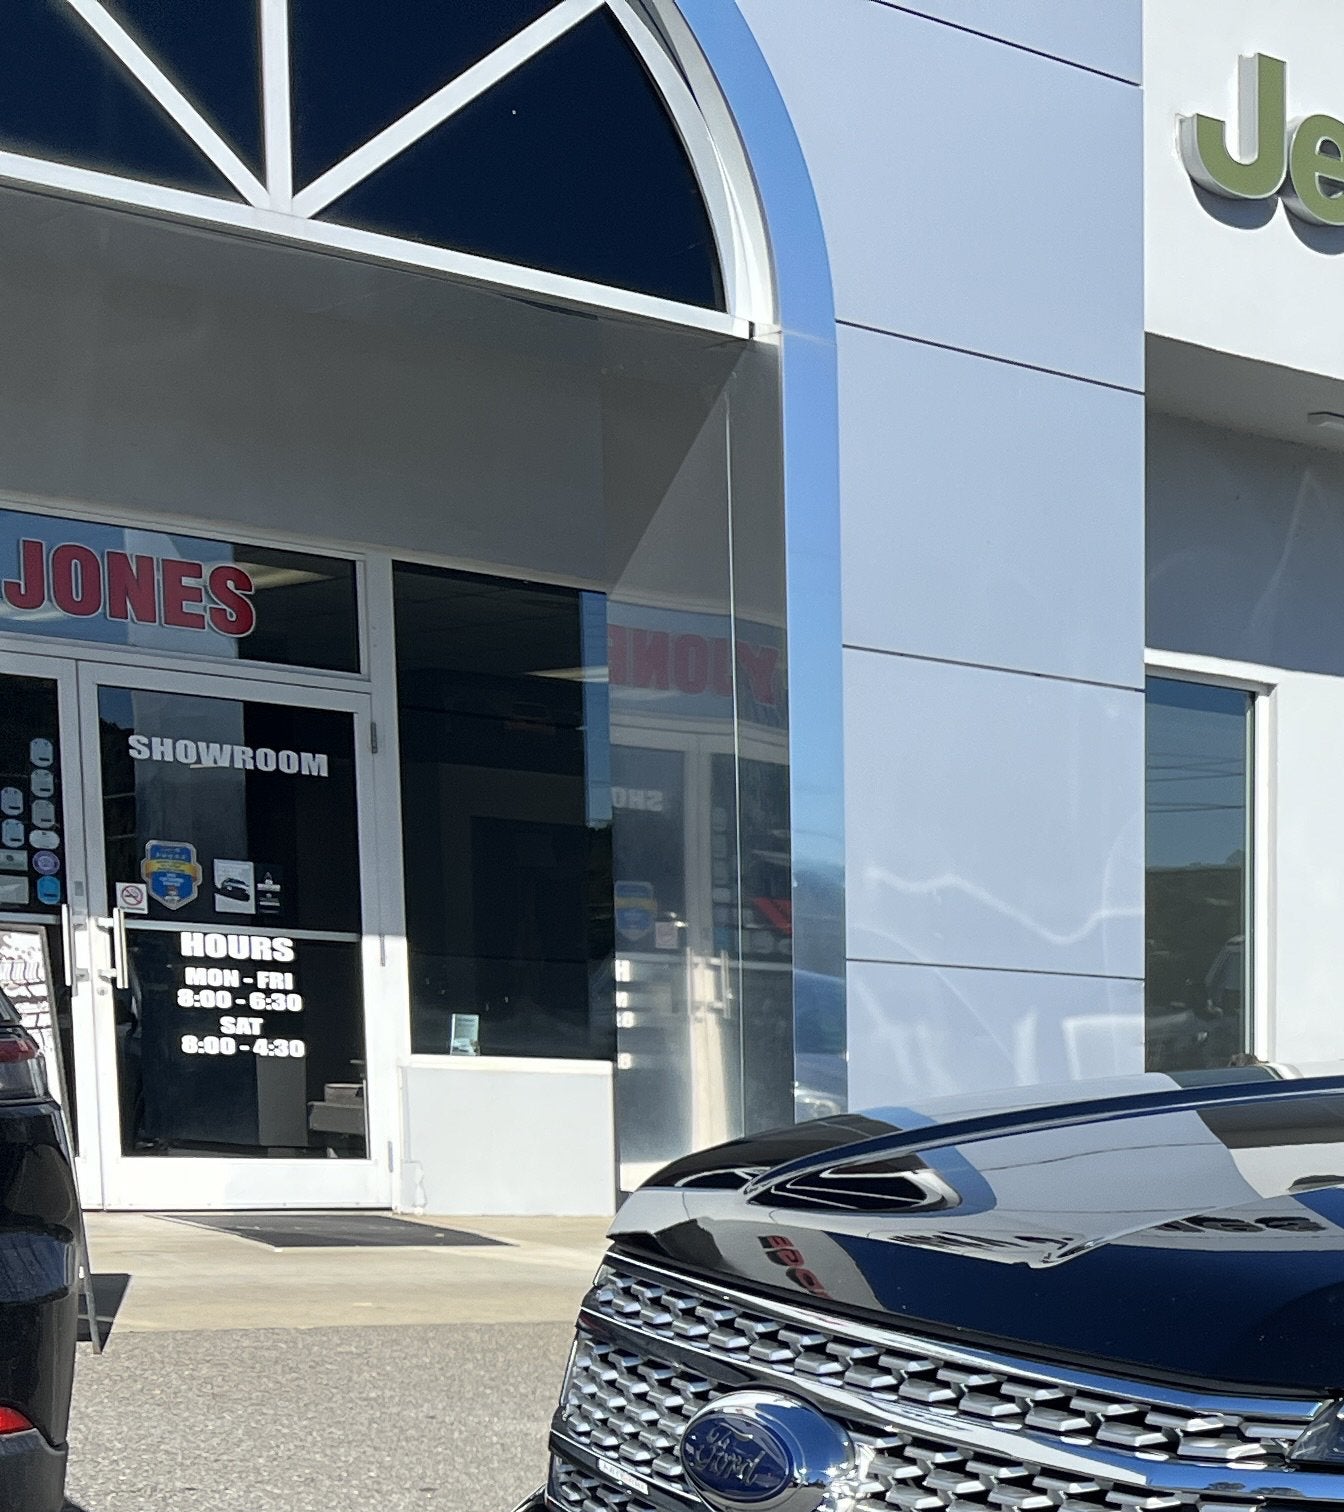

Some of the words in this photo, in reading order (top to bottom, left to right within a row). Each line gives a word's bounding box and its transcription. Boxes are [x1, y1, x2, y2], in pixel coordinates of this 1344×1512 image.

[3, 537, 256, 638] JONES
[128, 735, 329, 778] SHOWROOM
[180, 931, 295, 962] HOURS
[185, 966, 240, 988] MON
[256, 970, 293, 990] FRI
[177, 988, 232, 1009] 8:00
[249, 991, 302, 1012] 6:30
[220, 1015, 264, 1036] SAT
[181, 1034, 236, 1056] 8:00
[252, 1037, 305, 1058] 4:30
[695, 1421, 767, 1486] Ford
